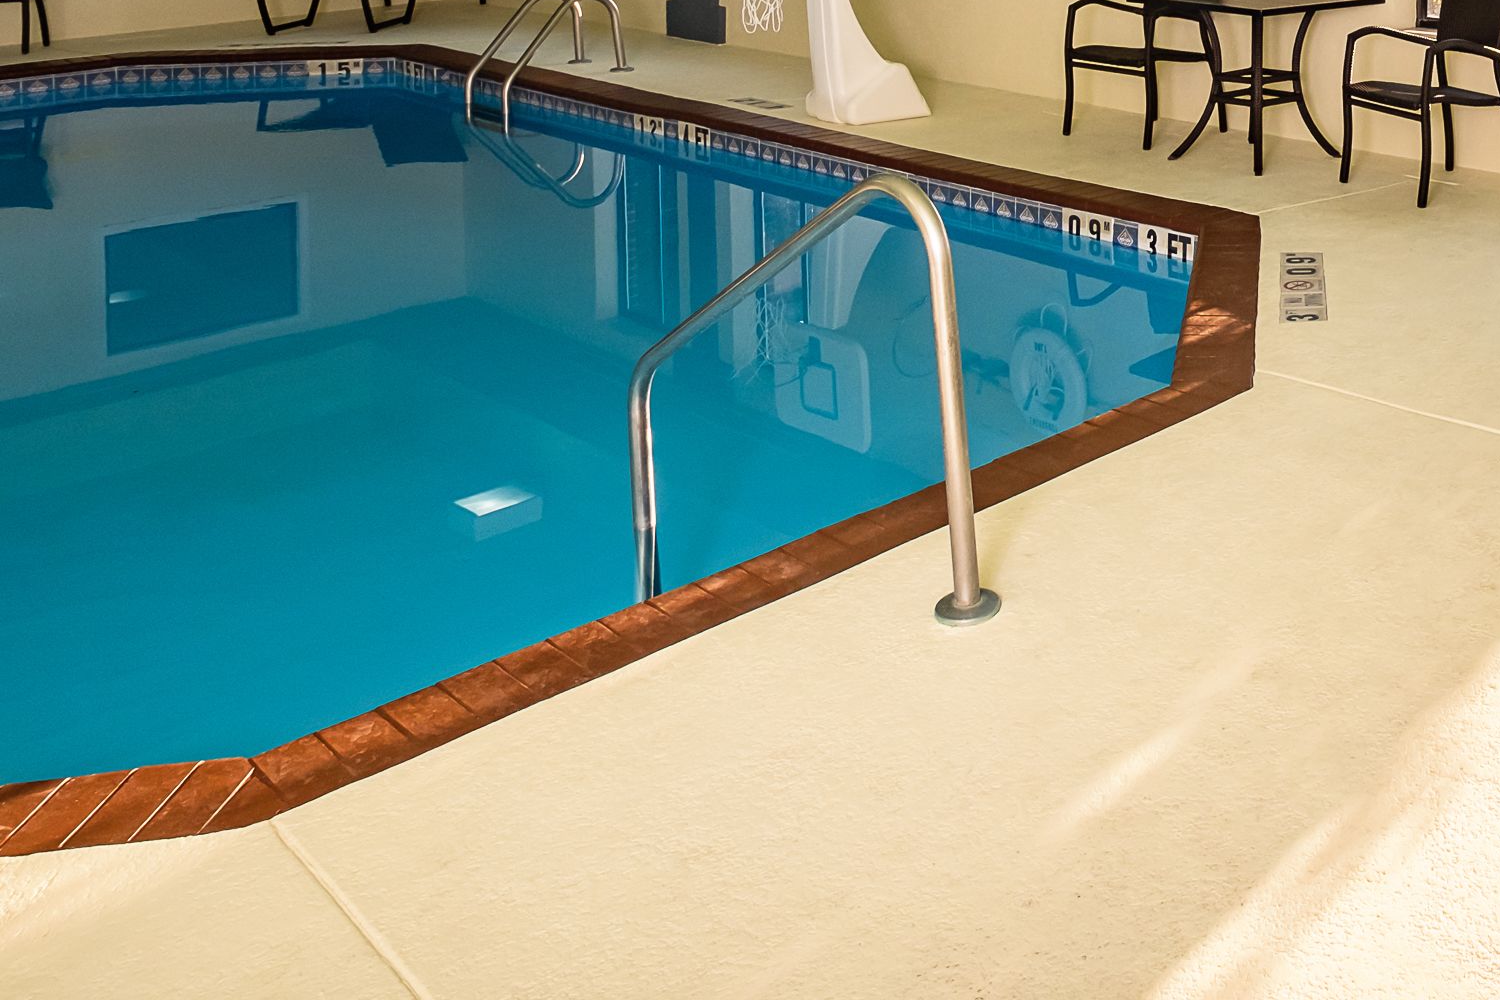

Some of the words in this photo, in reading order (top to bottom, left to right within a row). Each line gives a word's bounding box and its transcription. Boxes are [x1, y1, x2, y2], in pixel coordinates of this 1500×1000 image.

[695, 127, 709, 147] FT
[1147, 229, 1157, 255] 3
[1168, 233, 1191, 262] FT
